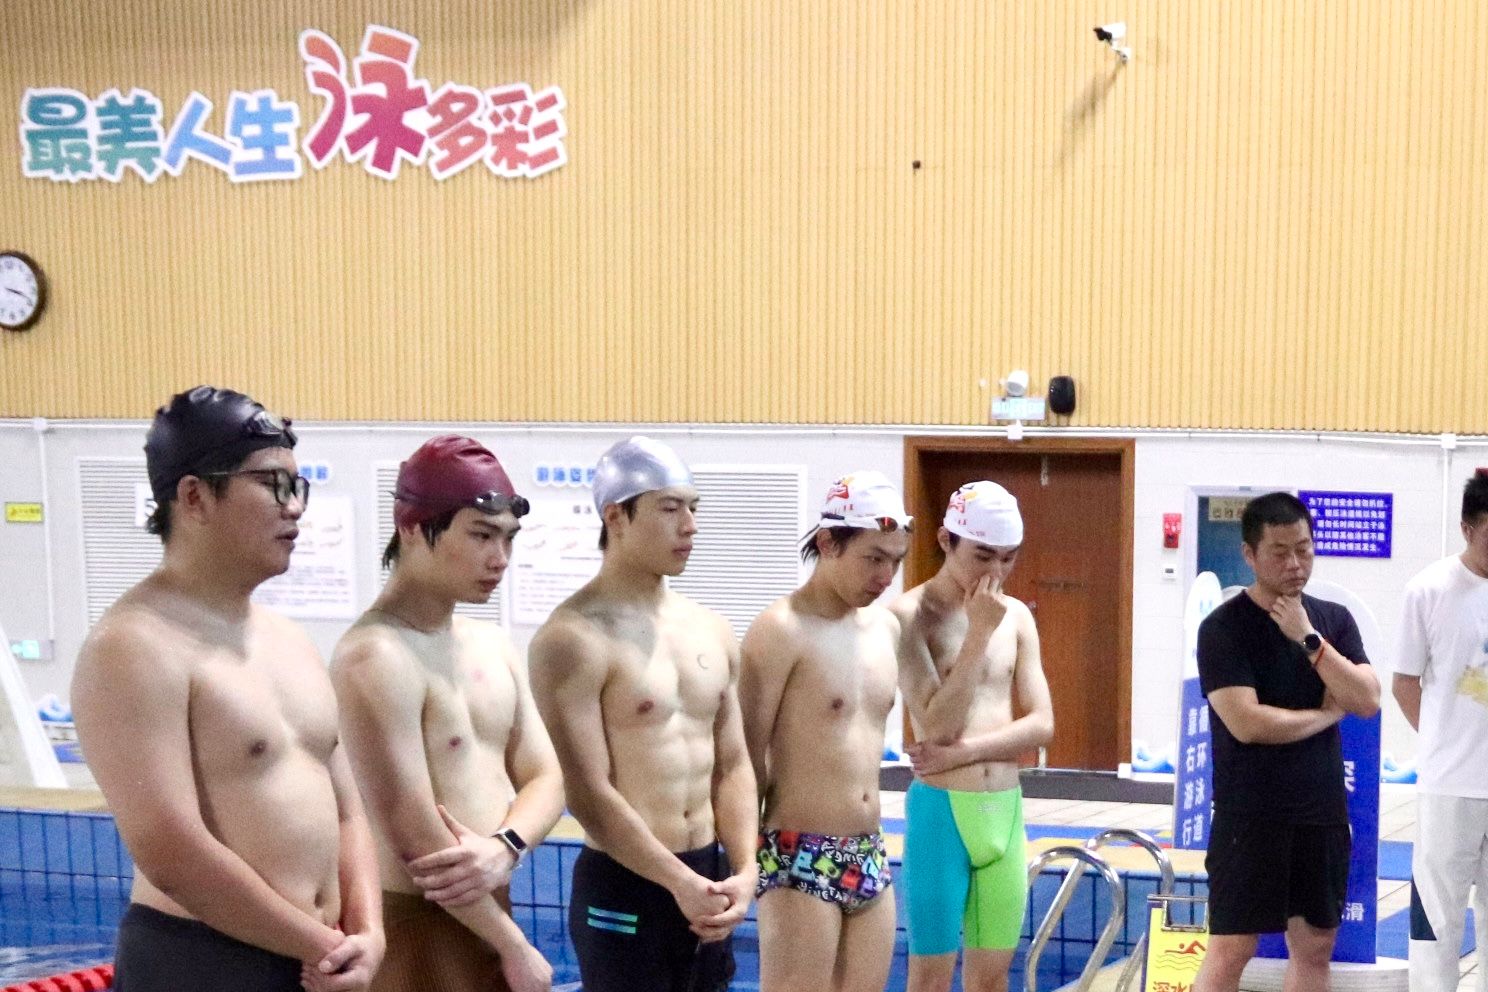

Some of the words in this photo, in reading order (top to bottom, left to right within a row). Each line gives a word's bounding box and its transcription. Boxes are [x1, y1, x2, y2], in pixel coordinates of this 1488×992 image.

[22, 26, 566, 183] 最美人生泳多彩
